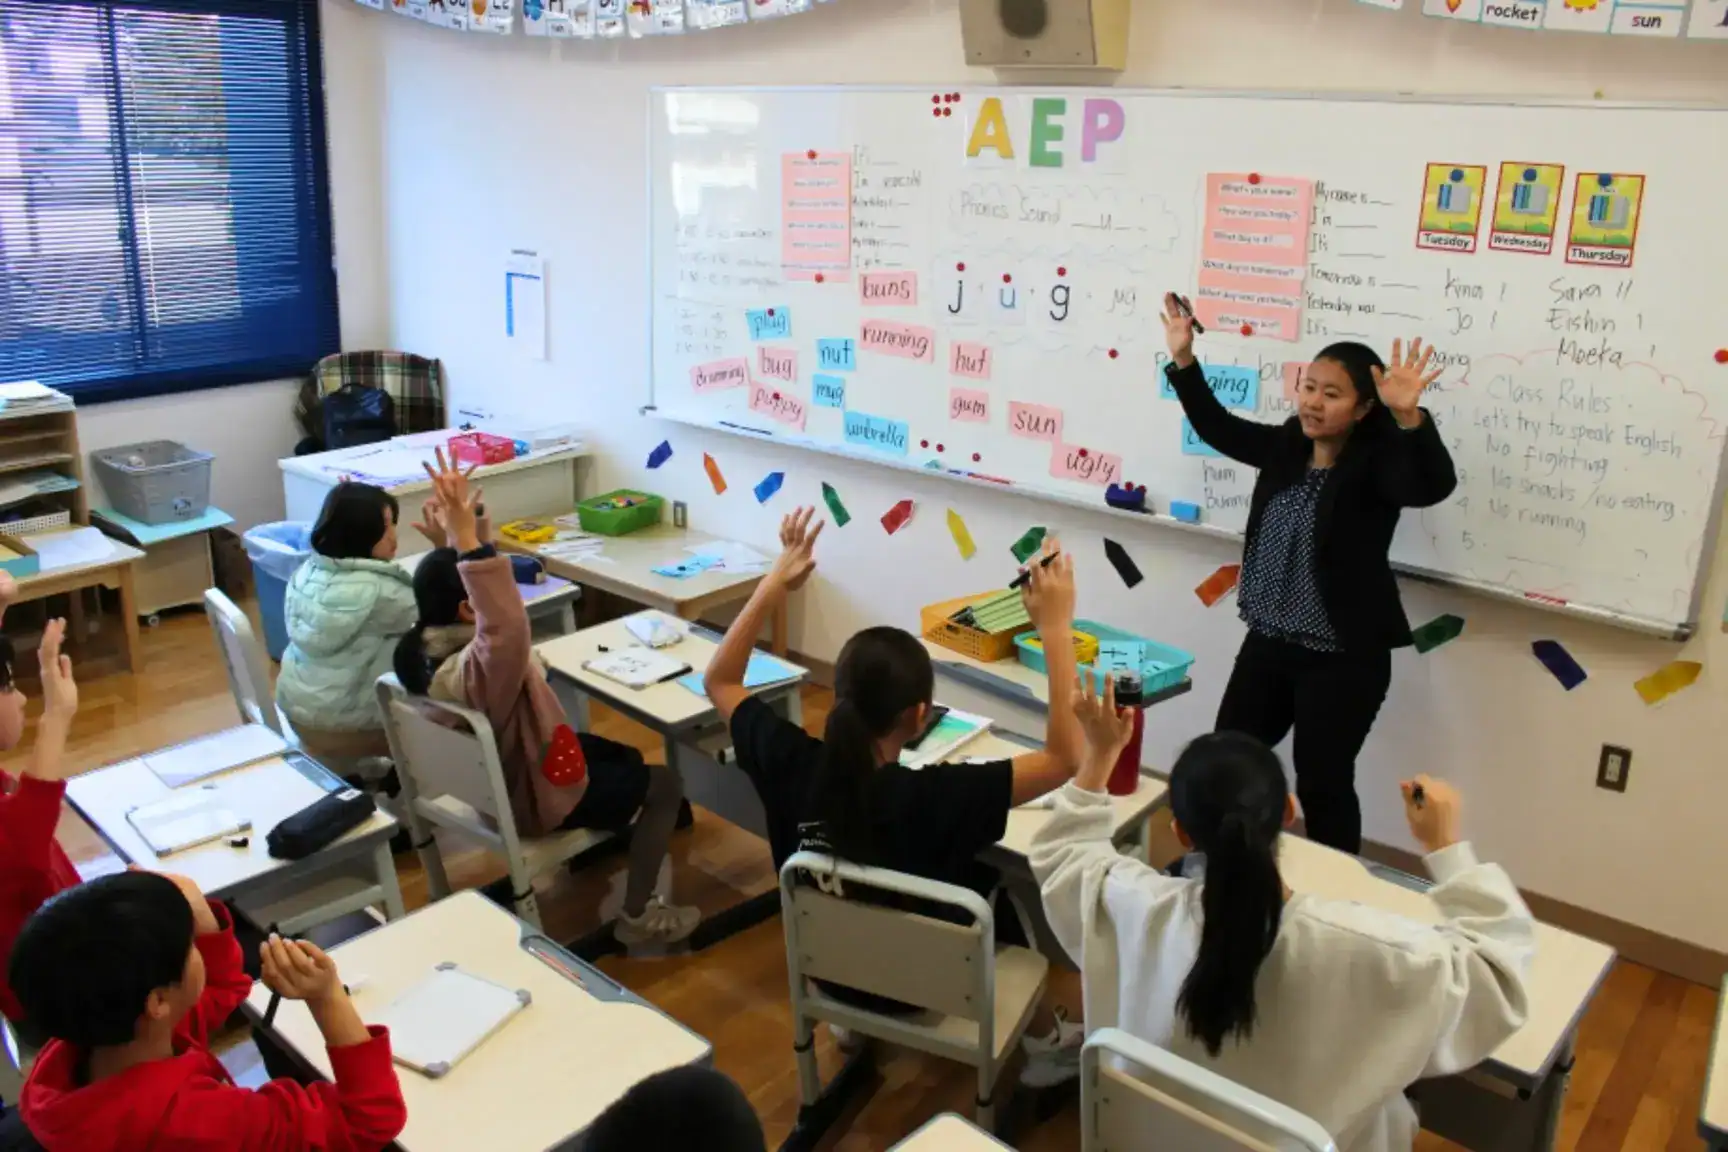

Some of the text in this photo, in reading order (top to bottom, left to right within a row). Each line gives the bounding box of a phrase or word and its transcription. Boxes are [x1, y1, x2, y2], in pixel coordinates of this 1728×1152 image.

[1486, 4, 1539, 21] rocket
[1632, 14, 1662, 28] sun
[961, 191, 1009, 219] Phonics
[1020, 197, 1061, 224] Sound
[1423, 233, 1470, 249] Tuesday
[1493, 234, 1549, 251] Wednesday
[1571, 246, 1629, 264] Thursday
[862, 277, 911, 300] buns
[948, 280, 963, 314] j
[1000, 288, 1016, 309] u
[1050, 284, 1070, 321] g
[820, 340, 849, 365] nut
[862, 325, 930, 357] running
[761, 346, 793, 380] bug
[955, 346, 986, 373] hut
[816, 383, 844, 407] mug
[1487, 374, 1543, 404] Class
[952, 396, 986, 419] gum
[845, 418, 905, 448] umbrella
[1013, 410, 1057, 436] sun
[1473, 406, 1510, 429] Let's
[1518, 410, 1541, 439] try
[1549, 413, 1565, 436] to
[1570, 420, 1615, 447] speak
[1624, 424, 1682, 457] English
[1486, 433, 1512, 456] No
[1066, 453, 1116, 483] ugly
[1492, 464, 1512, 490] No
[1517, 506, 1587, 546] running
